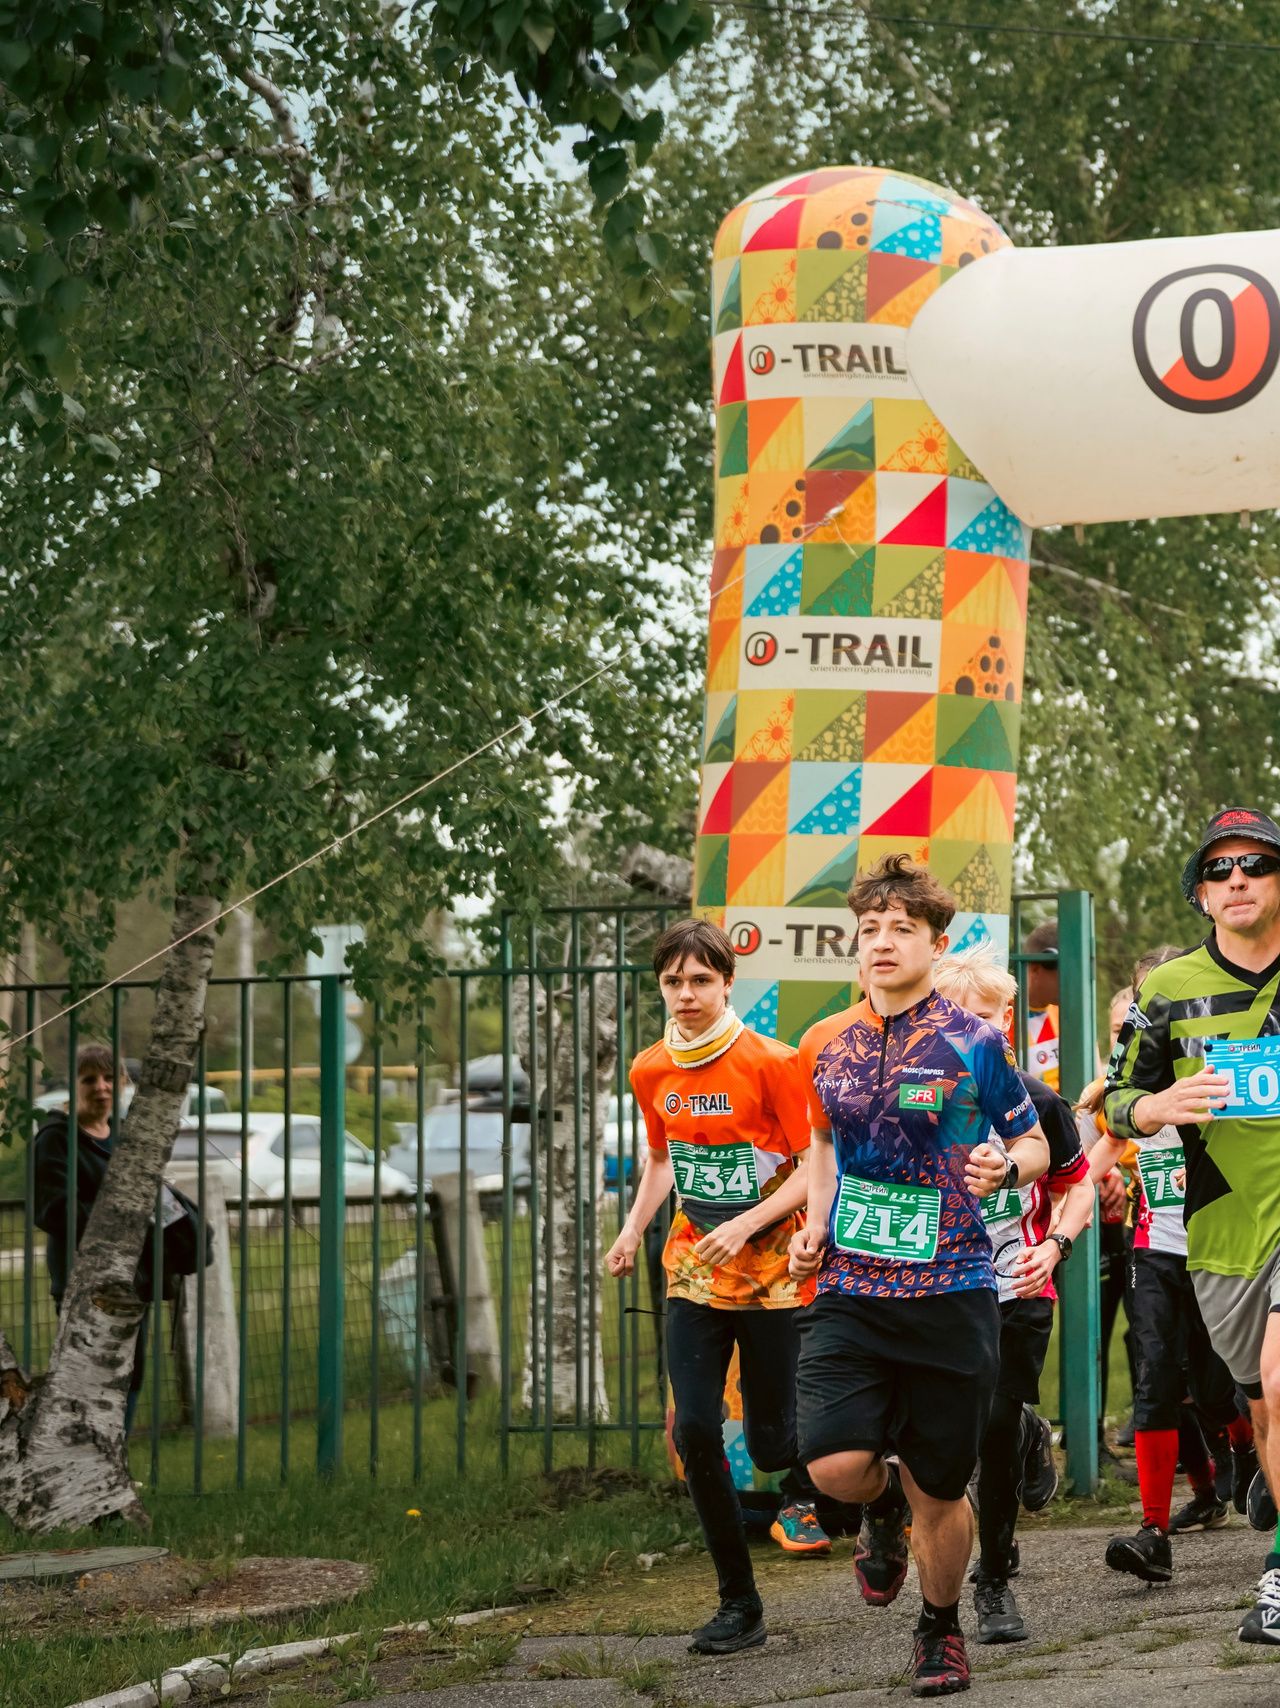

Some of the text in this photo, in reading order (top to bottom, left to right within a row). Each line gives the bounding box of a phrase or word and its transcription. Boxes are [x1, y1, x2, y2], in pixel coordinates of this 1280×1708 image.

[810, 664, 932, 677] orienteering&trailrunning
[794, 956, 861, 966] orienteering&
[907, 1089, 934, 1101] SFR
[677, 1160, 754, 1196] 734
[843, 1200, 929, 1249] 714
